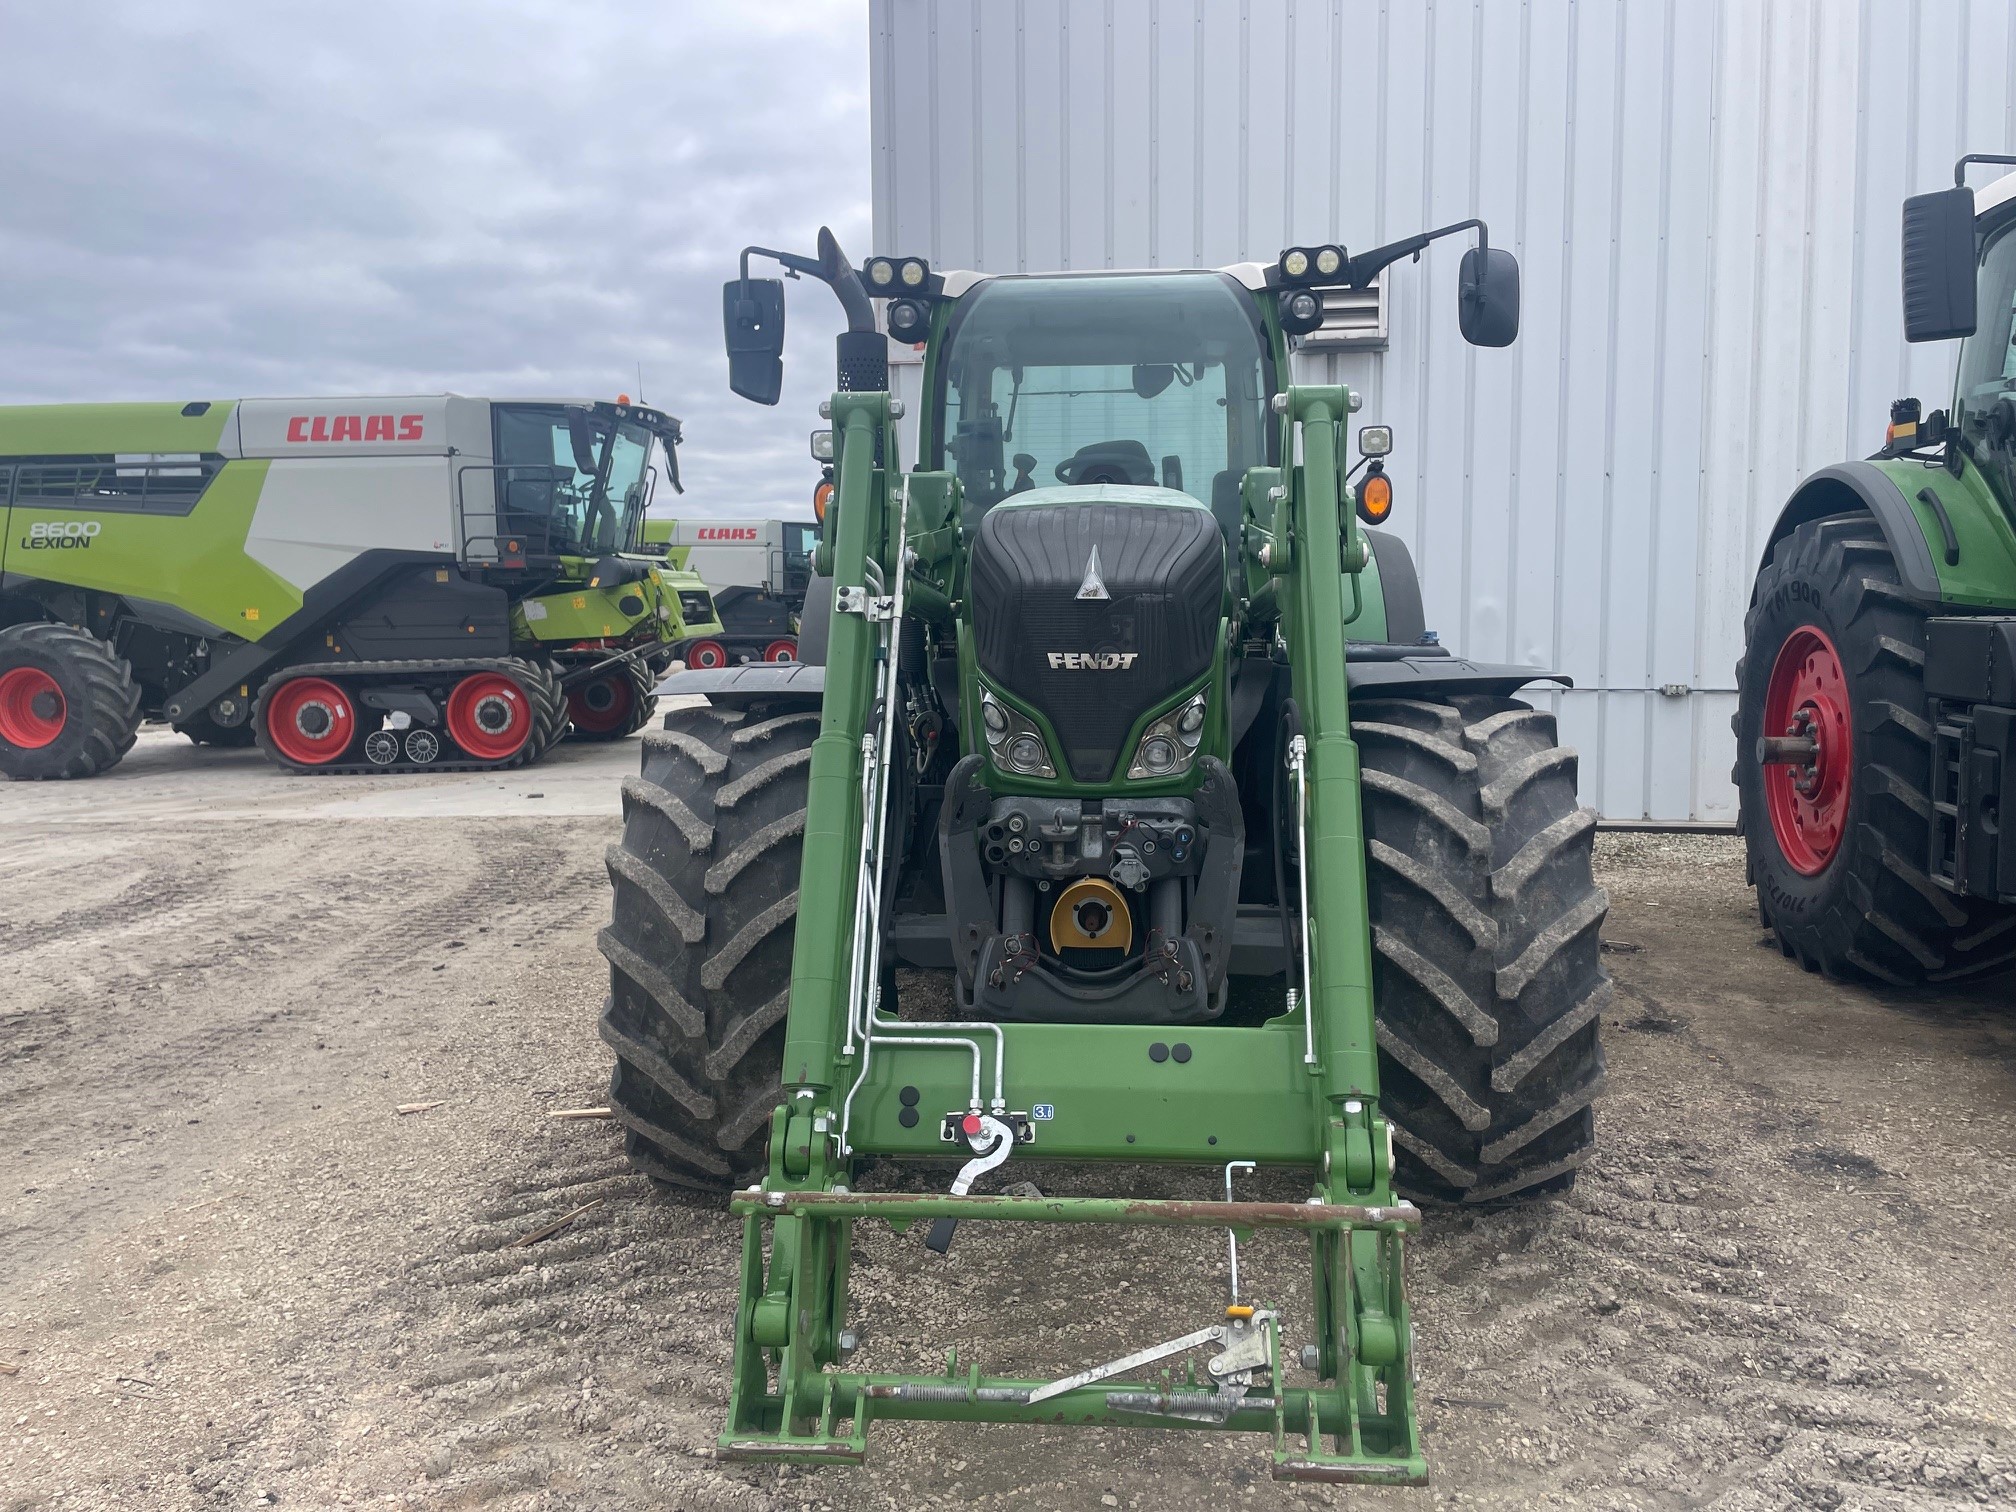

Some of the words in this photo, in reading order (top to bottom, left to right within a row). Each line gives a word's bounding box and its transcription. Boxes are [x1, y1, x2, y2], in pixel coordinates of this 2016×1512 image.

[286, 415, 424, 442] CLAAS
[30, 521, 101, 538] 8600
[697, 528, 757, 540] CLAAS
[21, 536, 90, 549] LEXION
[1047, 652, 1138, 670] FENDT
